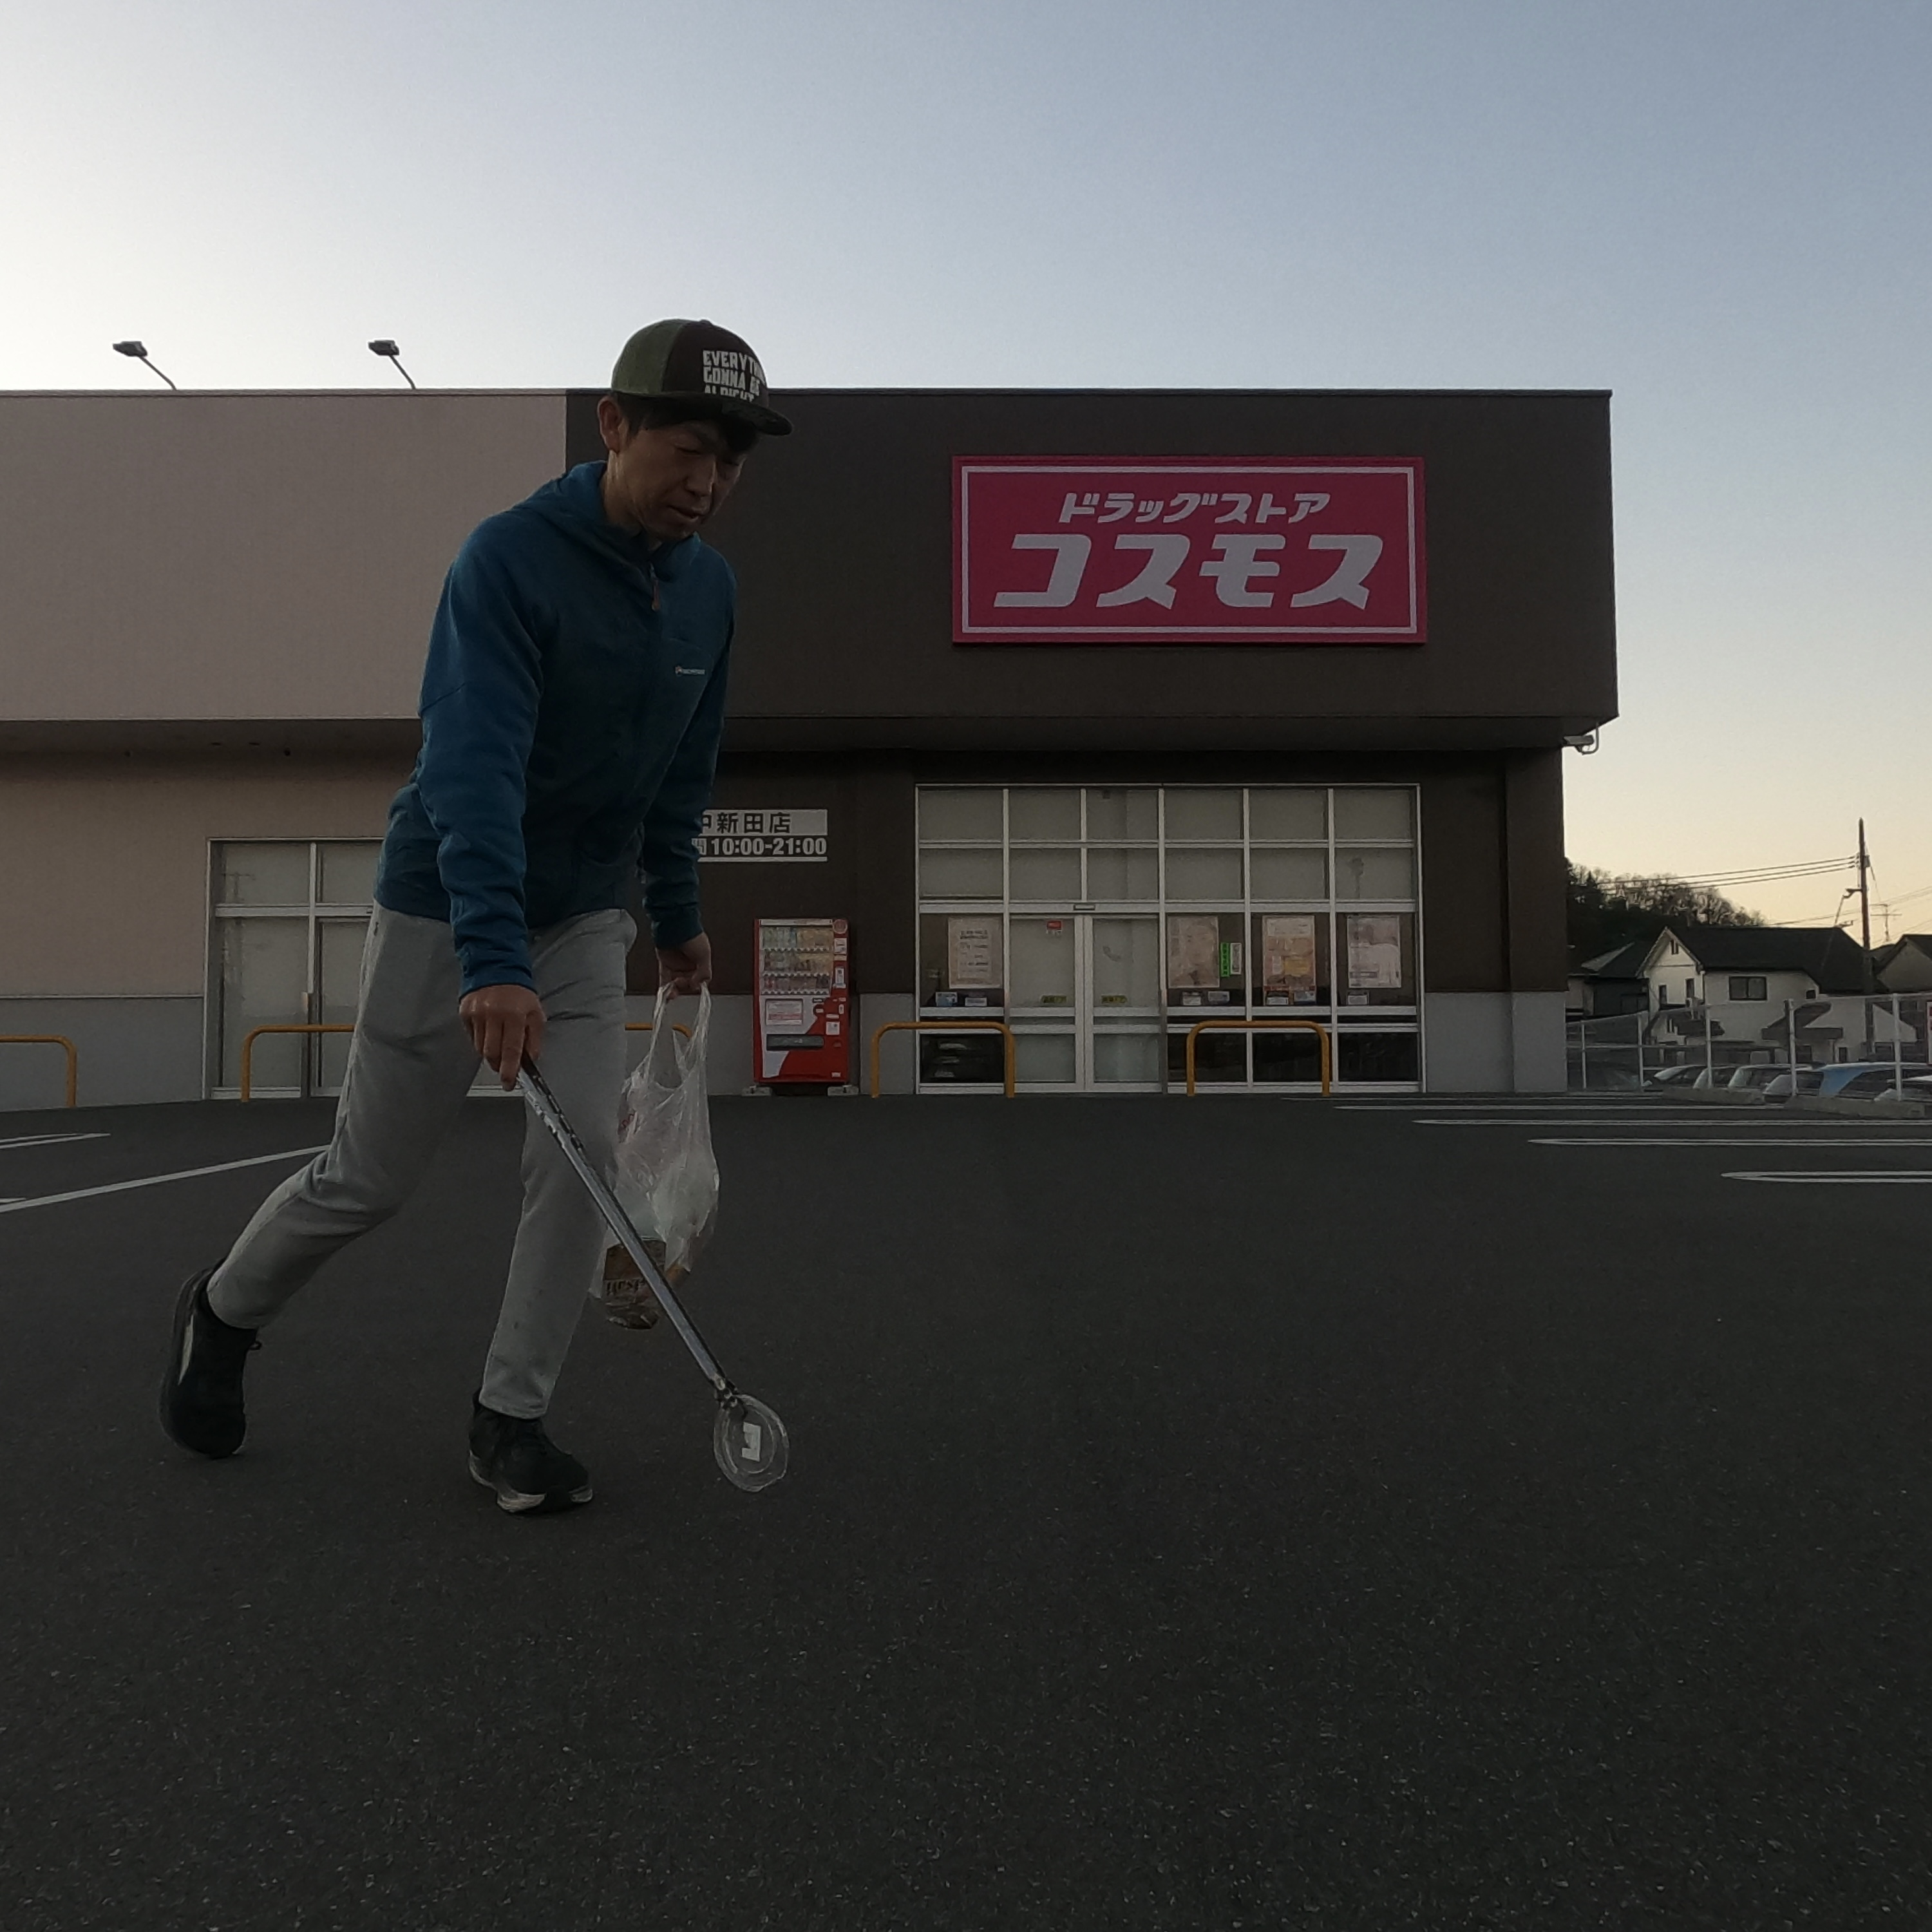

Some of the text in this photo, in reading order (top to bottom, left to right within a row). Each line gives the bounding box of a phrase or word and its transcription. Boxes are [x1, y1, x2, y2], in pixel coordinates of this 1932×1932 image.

[703, 366, 746, 390] GONNA
[1059, 493, 1331, 524] ドラッグストア
[994, 534, 1383, 609] コスモス
[711, 837, 827, 855] 10:00-21:00
